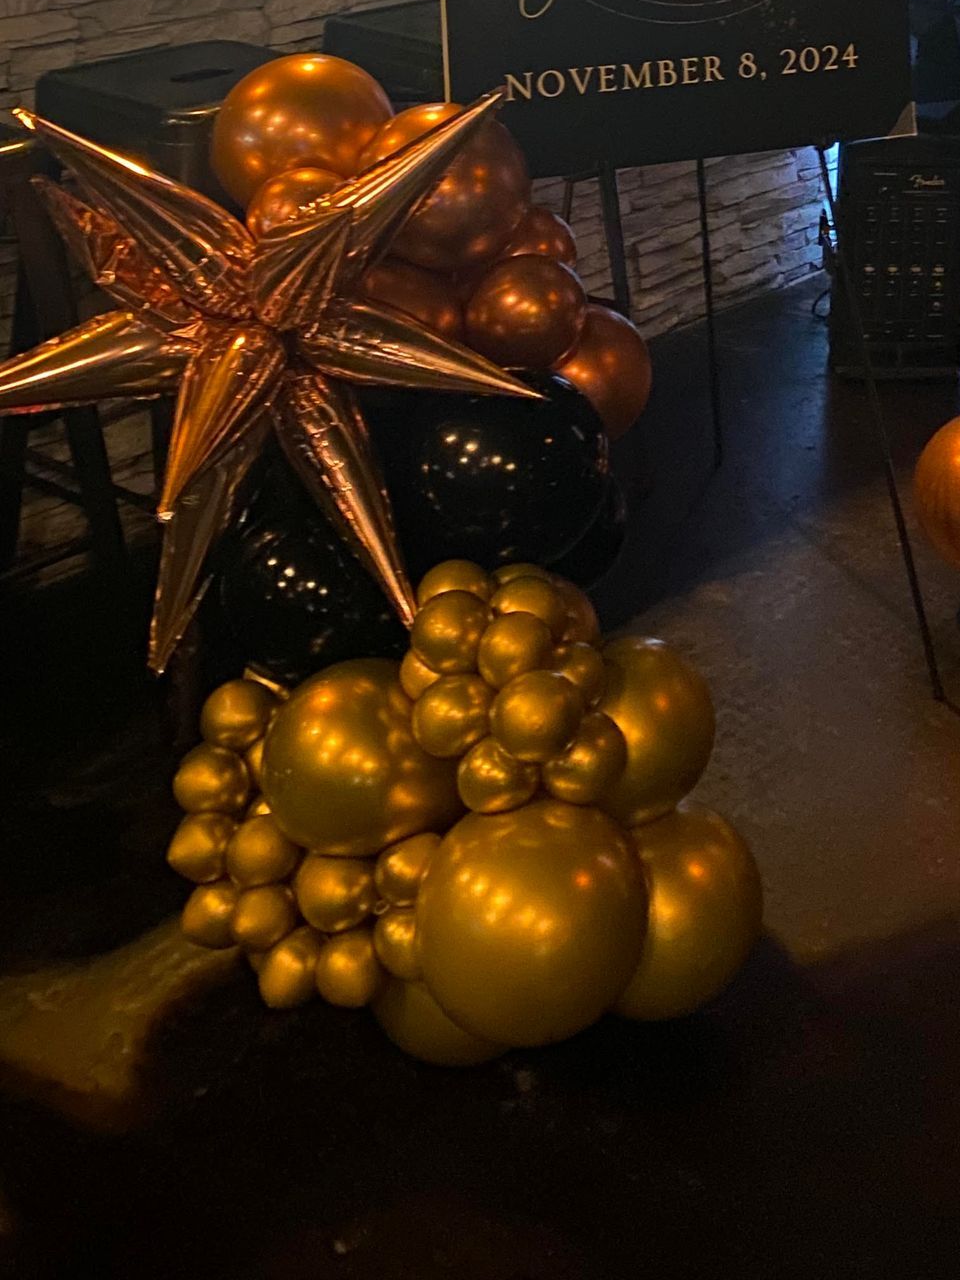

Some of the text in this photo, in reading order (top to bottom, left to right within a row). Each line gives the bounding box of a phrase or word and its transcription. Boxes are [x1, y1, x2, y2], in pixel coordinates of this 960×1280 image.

[503, 42, 860, 102] NOVEMBER 8, 2024
